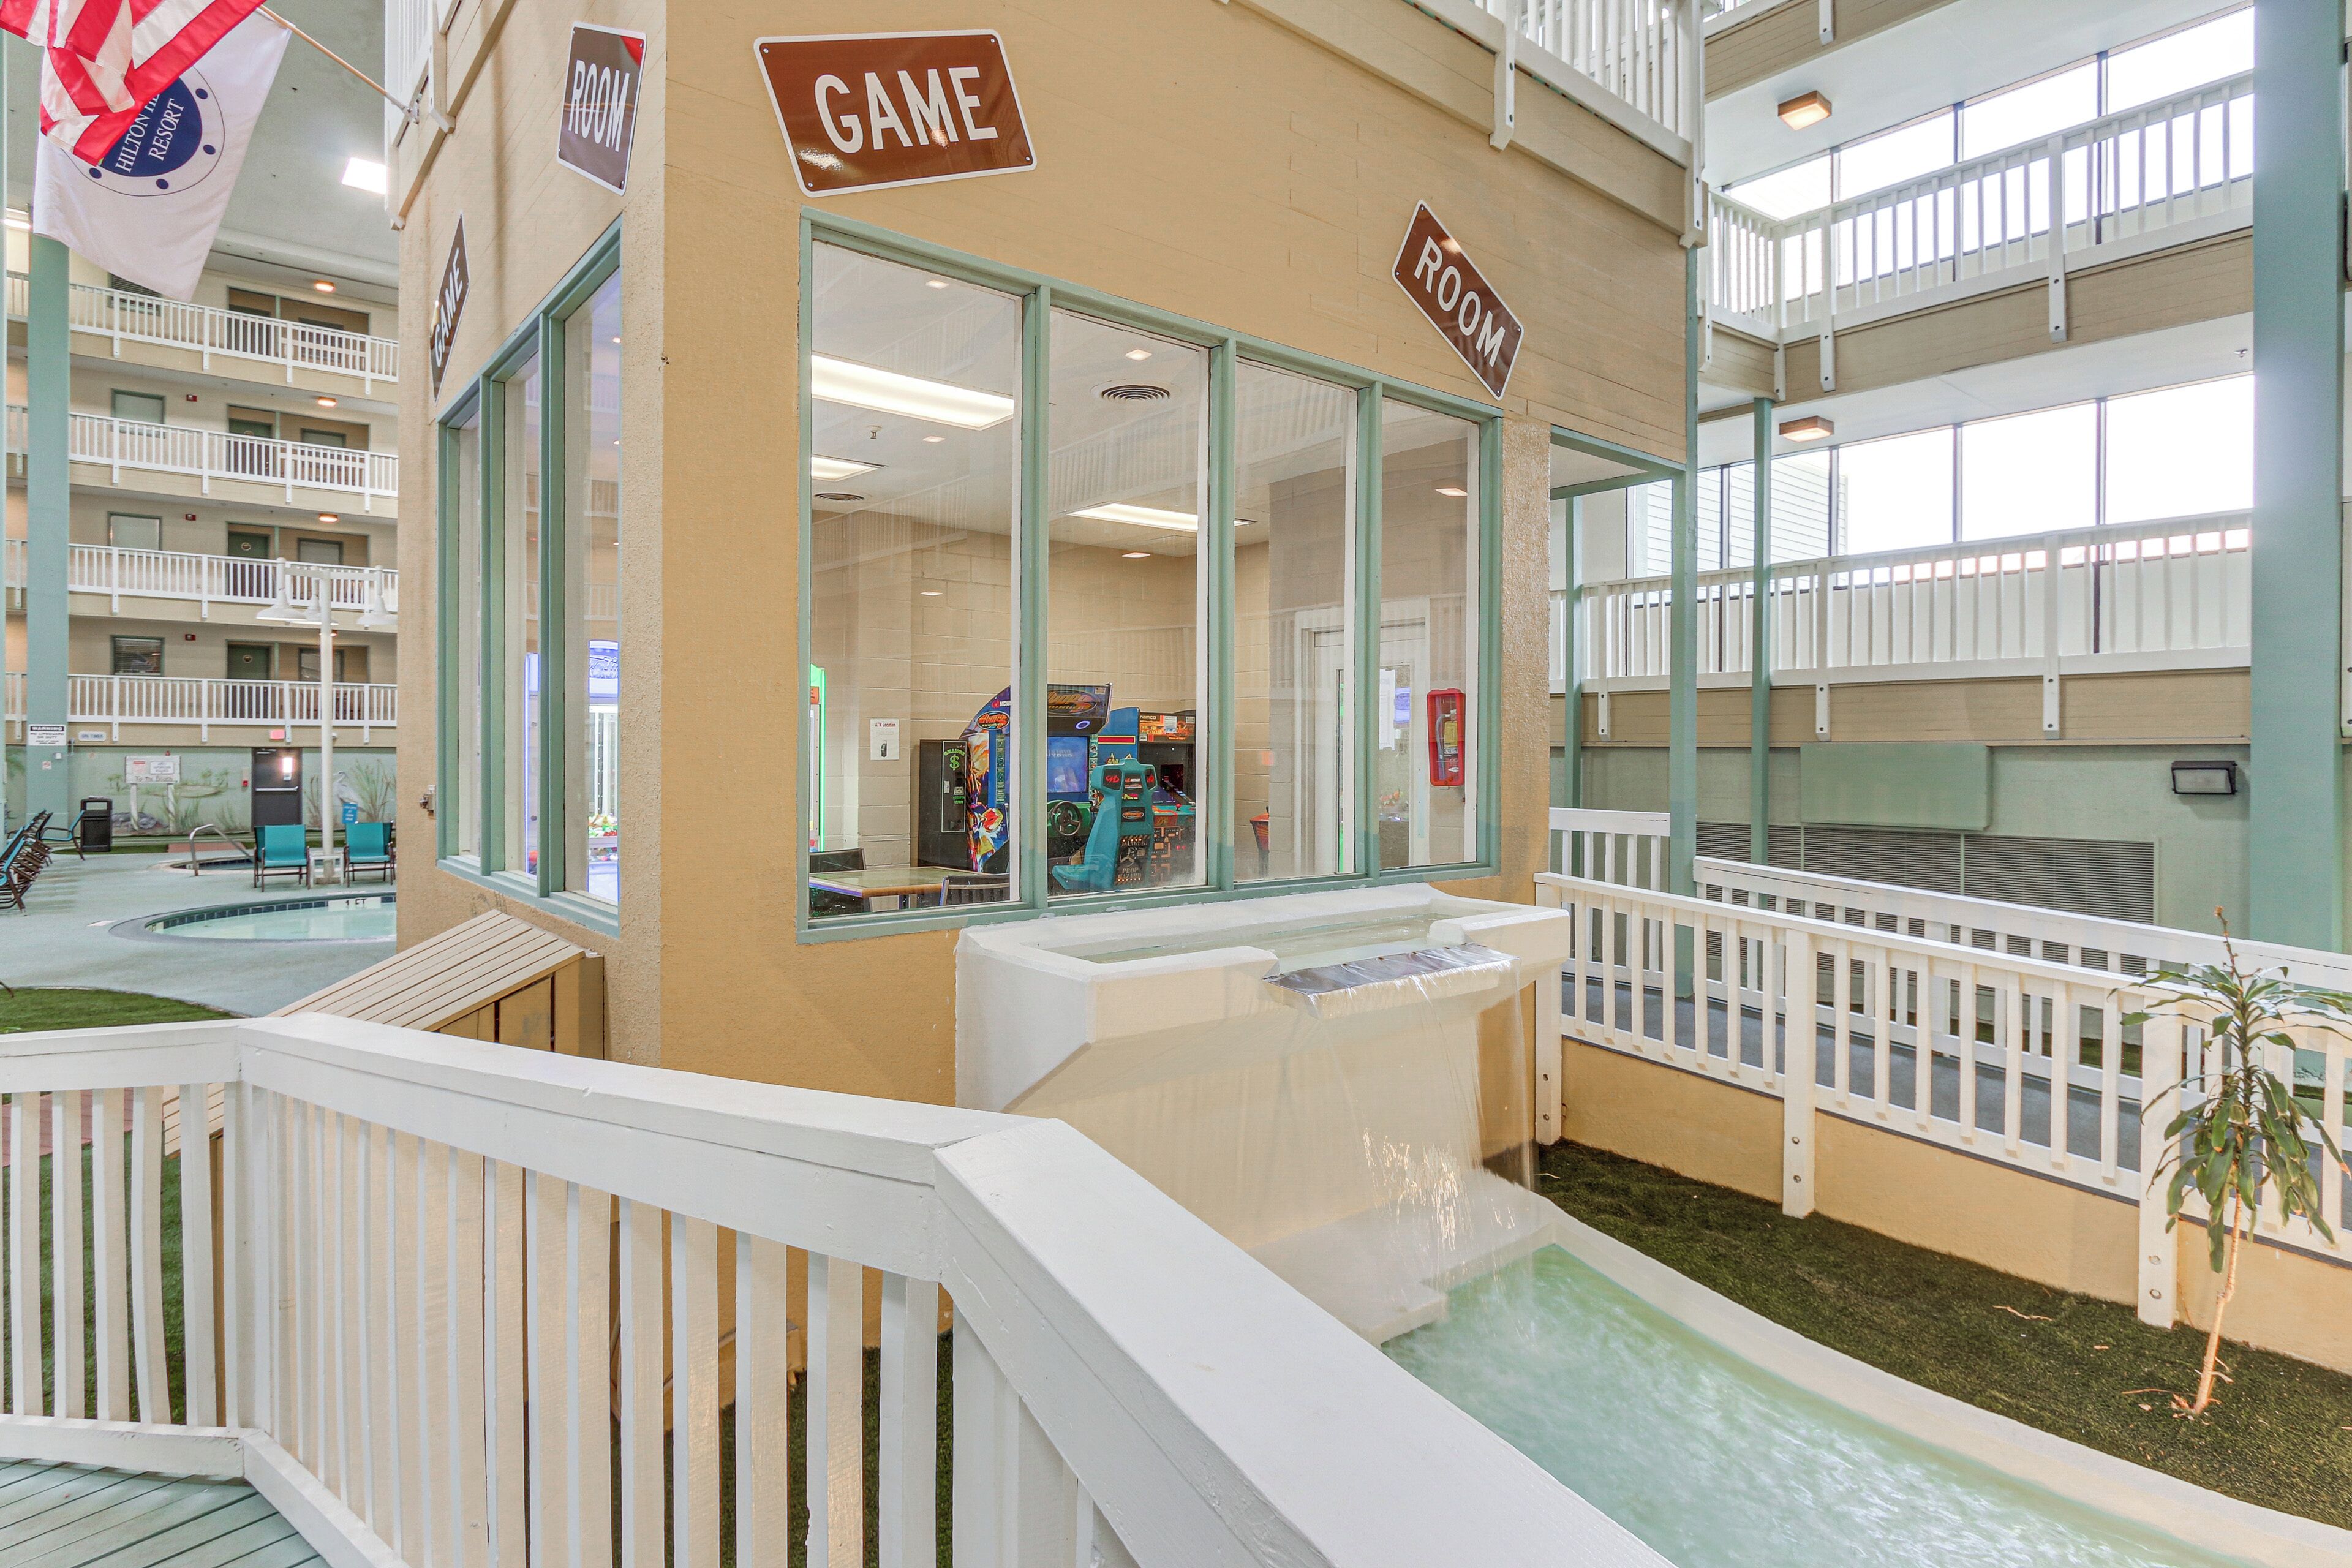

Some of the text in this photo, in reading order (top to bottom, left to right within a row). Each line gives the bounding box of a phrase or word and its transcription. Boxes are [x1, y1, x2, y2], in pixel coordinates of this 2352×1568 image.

[115, 113, 151, 173] HILTON
[148, 98, 184, 161] RESORT
[568, 59, 630, 152] ROOM
[814, 66, 998, 153] GAME
[435, 247, 463, 368] GAME
[1414, 236, 1506, 368] ROOM
